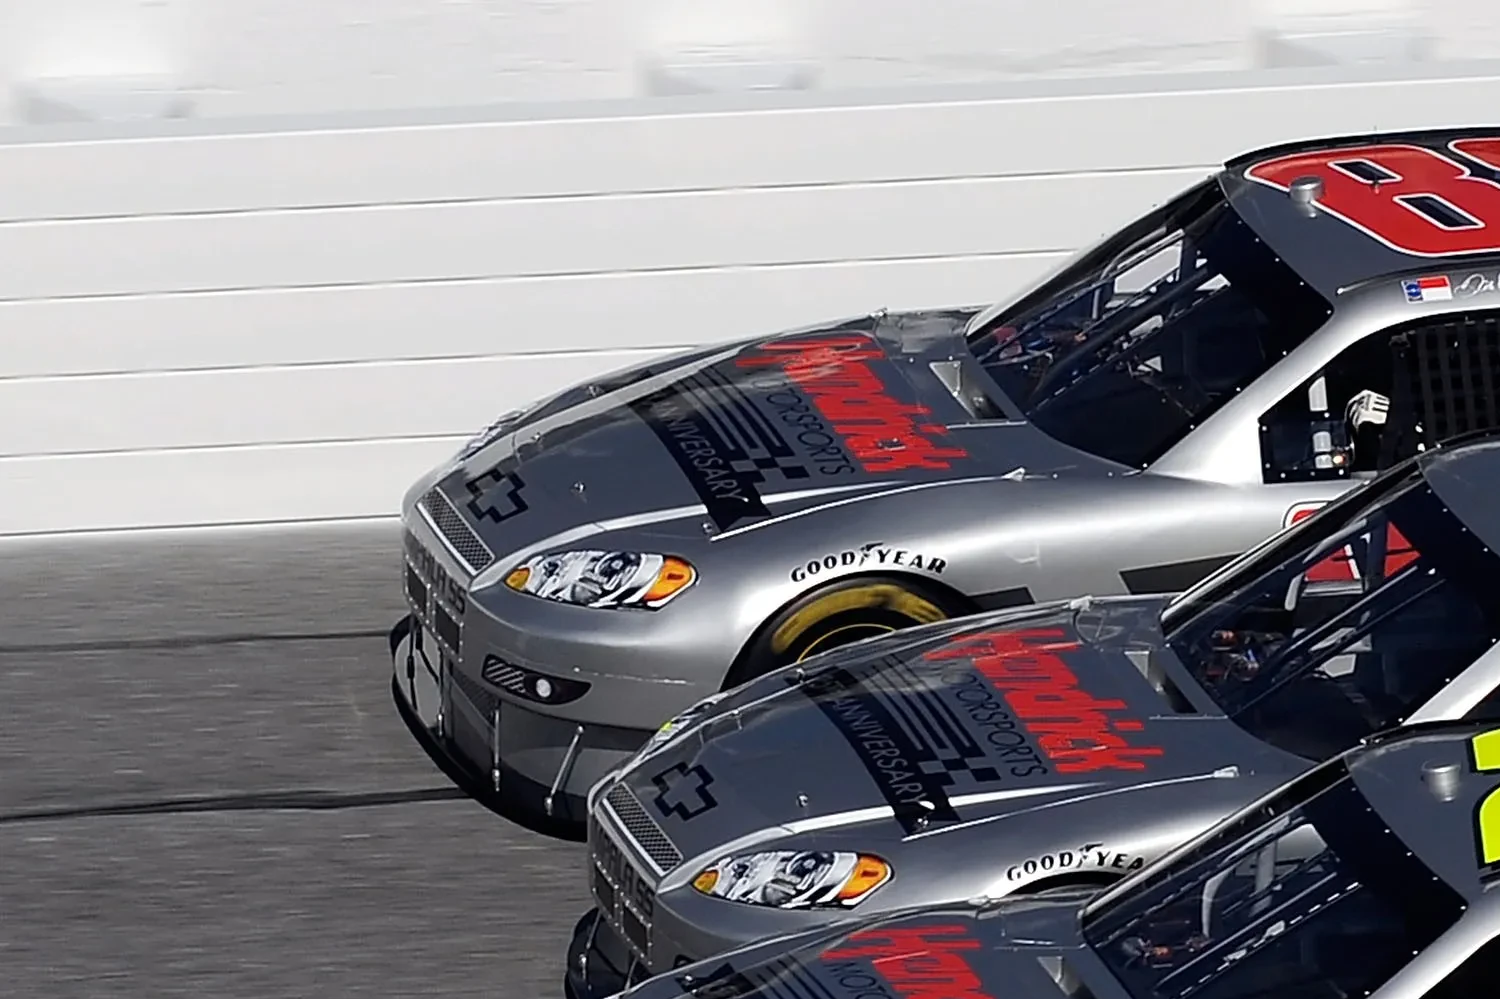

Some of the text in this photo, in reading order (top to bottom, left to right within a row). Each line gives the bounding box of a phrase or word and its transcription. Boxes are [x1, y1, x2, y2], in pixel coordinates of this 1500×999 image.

[736, 336, 970, 473] Hendrick
[832, 694, 930, 804] ANNIVERSARY
[922, 628, 1165, 775] Hendrick
